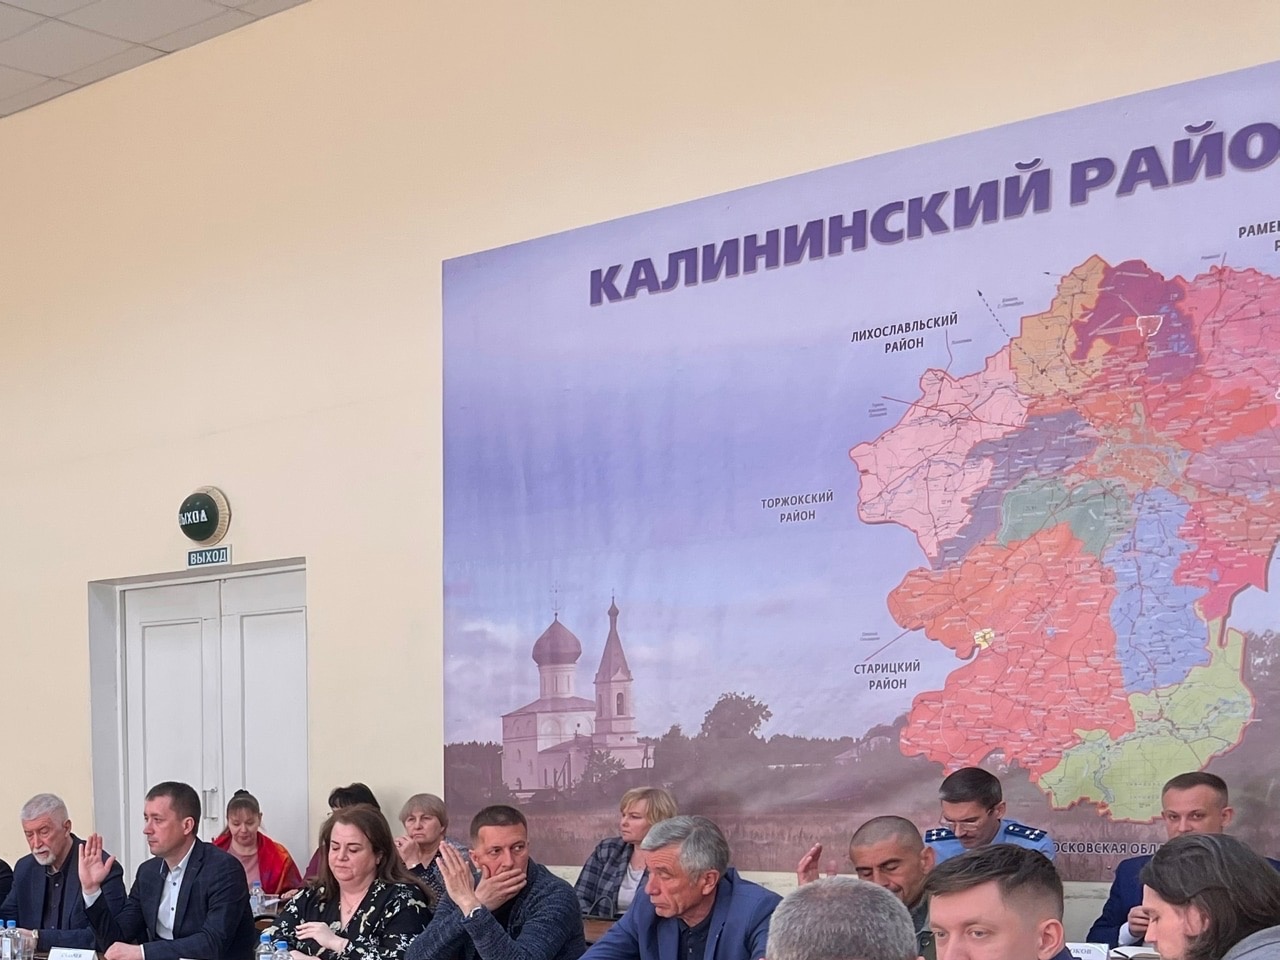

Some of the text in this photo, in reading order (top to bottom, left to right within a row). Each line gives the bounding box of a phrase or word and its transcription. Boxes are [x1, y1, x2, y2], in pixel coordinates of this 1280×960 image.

[588, 158, 1051, 306] КАЛИНИНСКИЙ
[1238, 220, 1280, 238] РАМЕ
[851, 311, 958, 342] ЛИХОСЛАВЛЬСКИЙ
[885, 337, 924, 353] РАЙОН
[761, 489, 834, 509] ТОРЖОКСКИЙ
[780, 509, 816, 523] РАЙОН
[190, 549, 227, 565] ВЫХОД
[854, 659, 921, 674] СТАРИЦКИЙ
[869, 677, 907, 690] РАЙОН
[1053, 842, 1162, 854] ОСКОВСКАЯ ОБЛ
